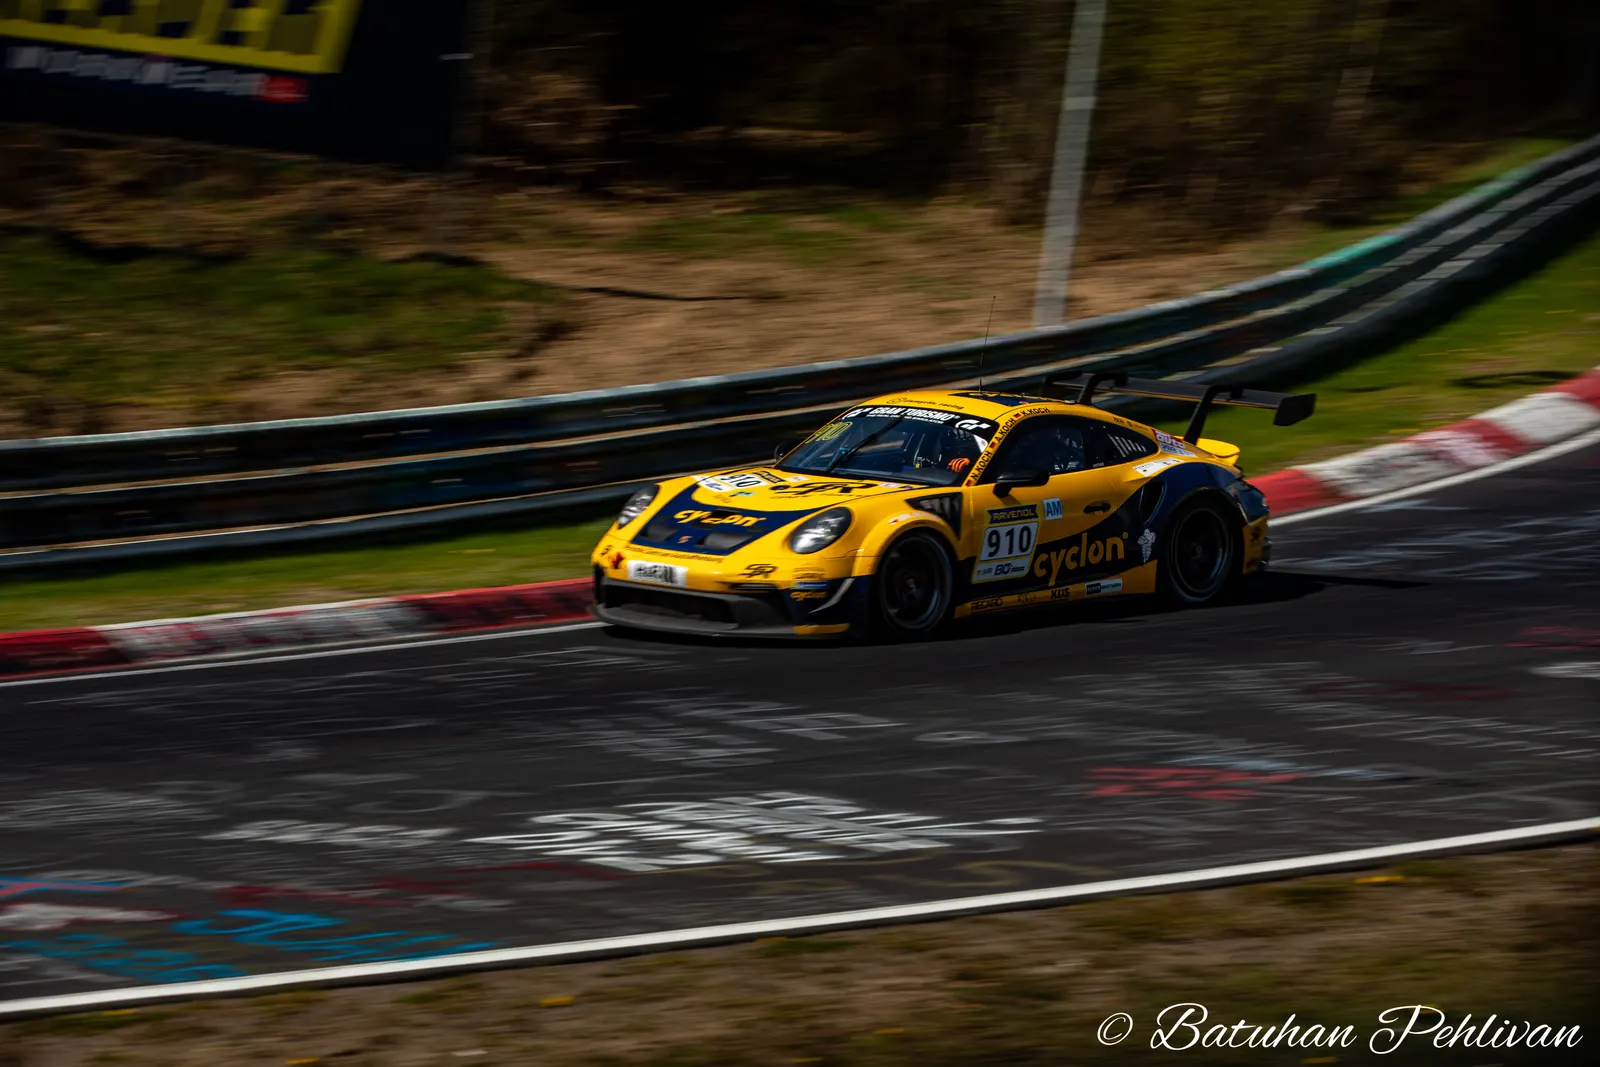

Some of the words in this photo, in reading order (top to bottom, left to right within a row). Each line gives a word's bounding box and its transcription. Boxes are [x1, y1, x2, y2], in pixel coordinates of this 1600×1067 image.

[868, 407, 906, 415] GRAN
[901, 408, 955, 420] TURISMO
[970, 451, 993, 480] N.KOCH
[995, 418, 1017, 442] A.KOCH
[993, 509, 1035, 520] RAVENOL
[1046, 501, 1062, 517] AM
[987, 525, 1032, 558] 910
[1034, 532, 1125, 587] cyclon
